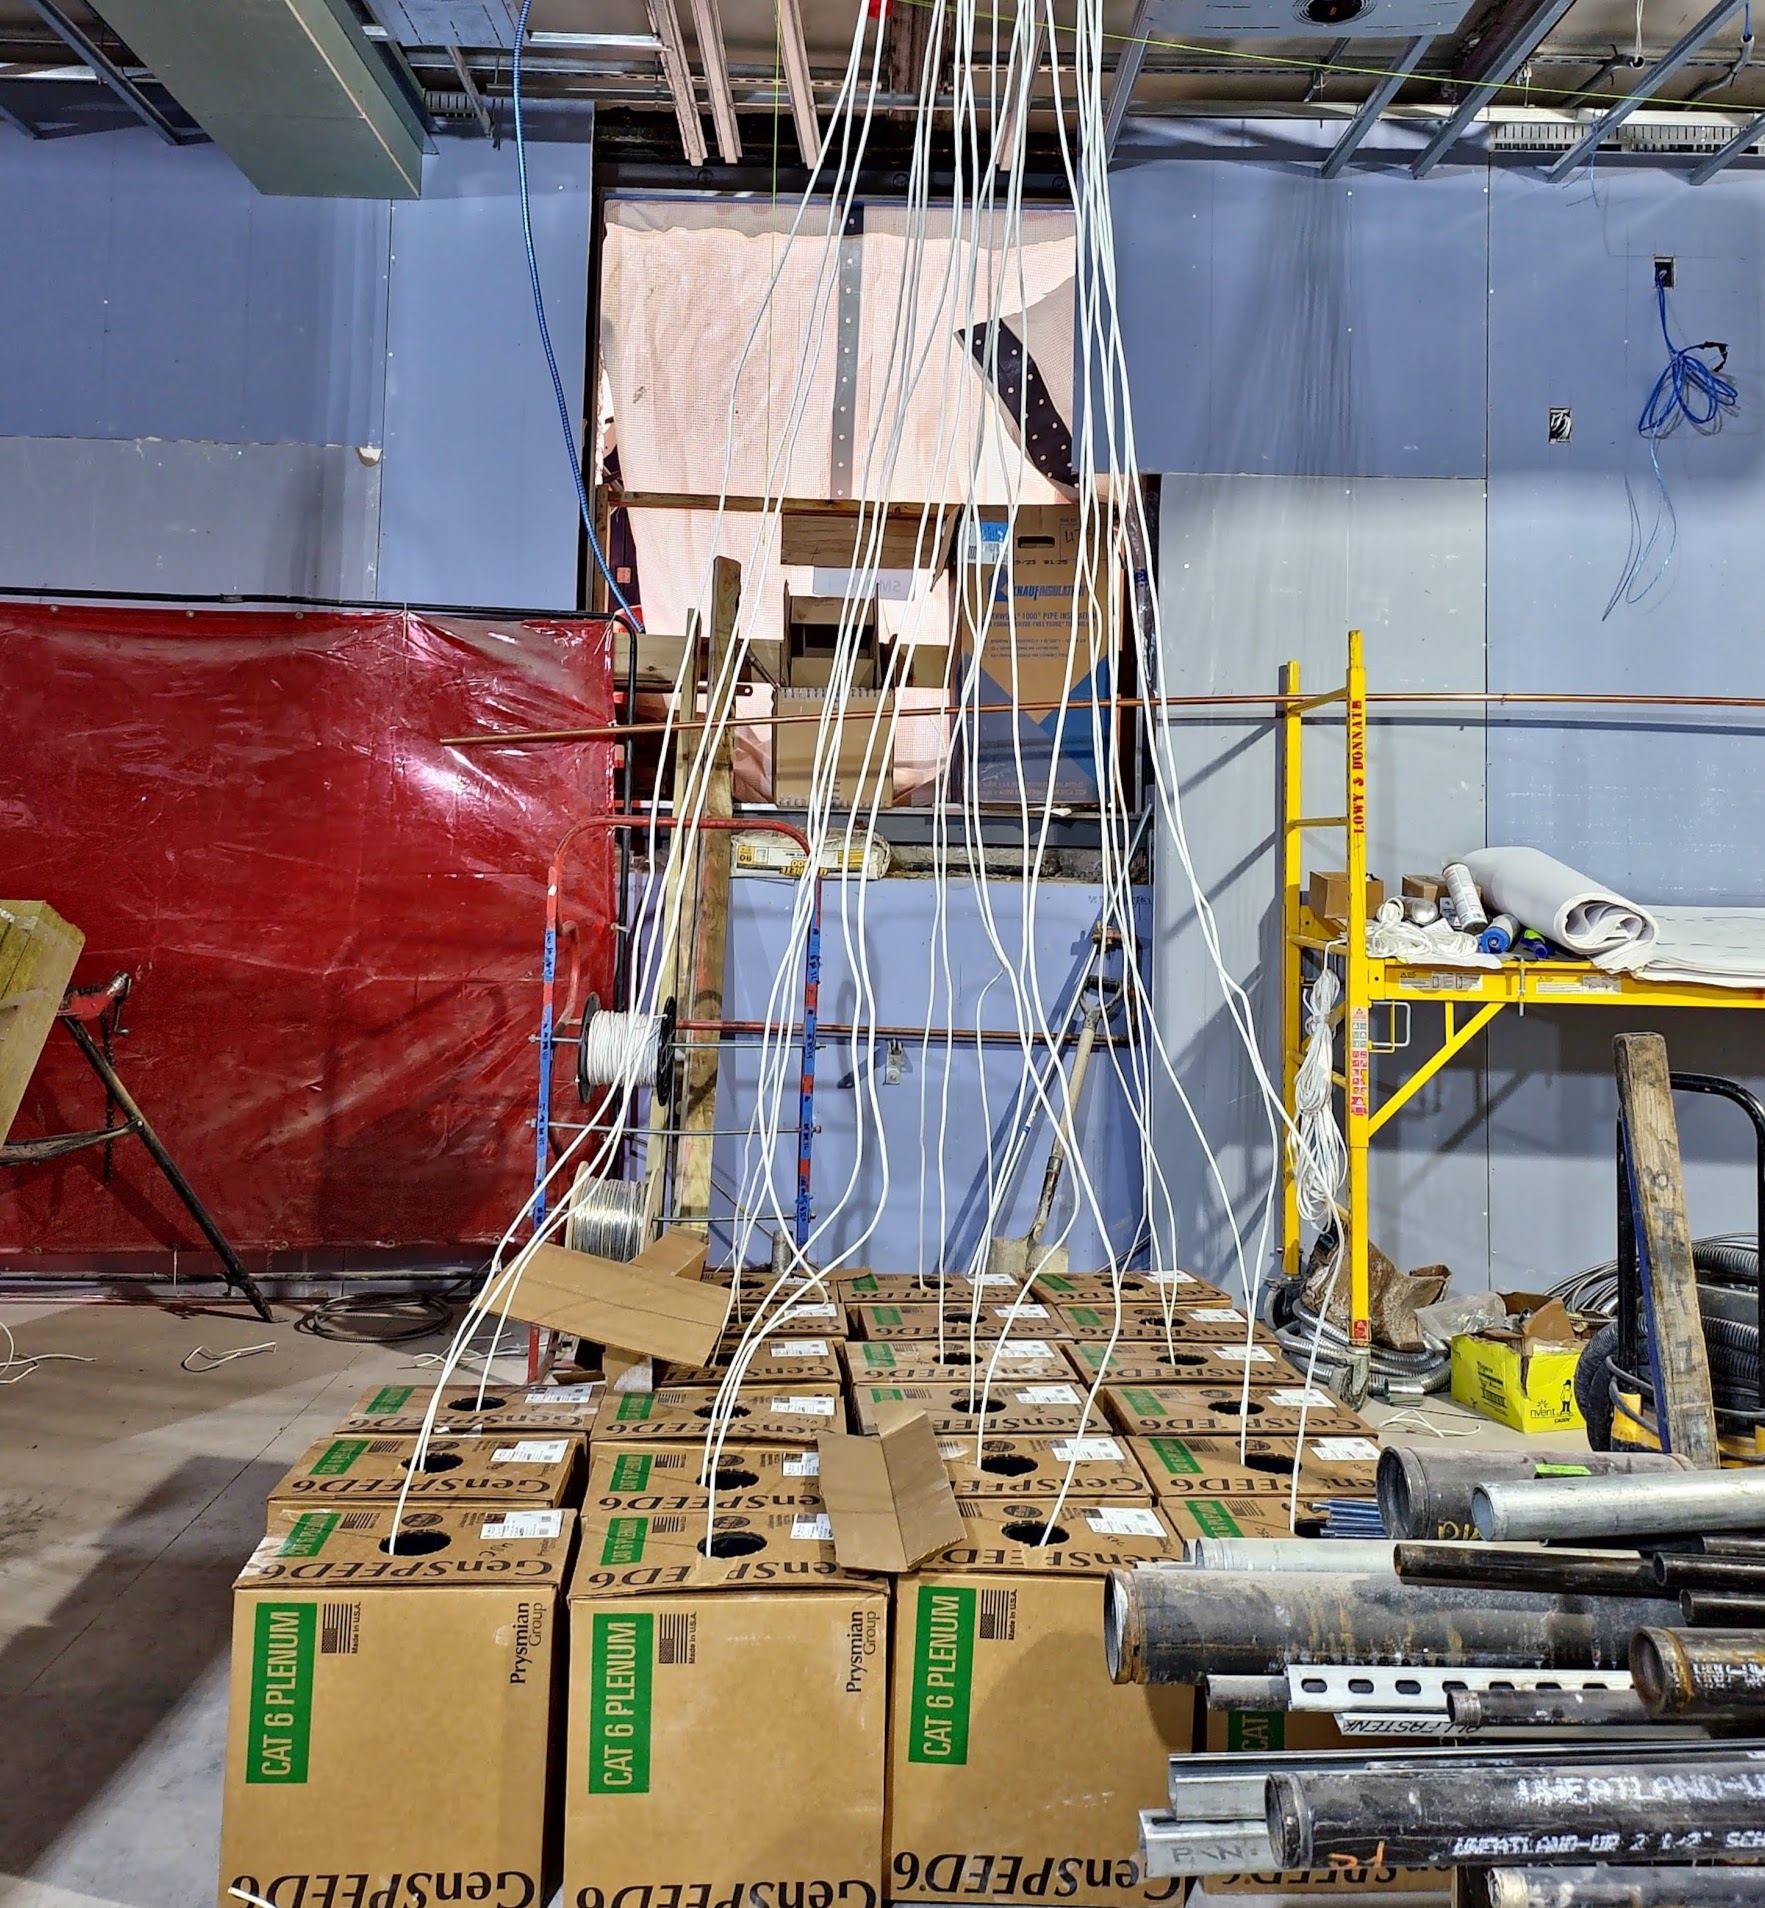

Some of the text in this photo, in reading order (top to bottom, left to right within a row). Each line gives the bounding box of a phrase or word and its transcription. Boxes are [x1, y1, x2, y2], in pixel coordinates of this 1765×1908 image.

[933, 1416, 1099, 1433] GenSPEE
[1139, 1416, 1362, 1432] GenSPED6
[949, 1477, 1144, 1498] GenSPEE
[598, 1494, 824, 1511] enSPEED6
[1009, 1589, 1018, 1610] U.S.A.
[352, 1601, 361, 1623] U.S.A.
[689, 1611, 697, 1633] U.S.A.
[528, 1602, 548, 1647] Group
[862, 1611, 881, 1656] Group
[1006, 1622, 1015, 1641] Made
[351, 1633, 359, 1654] Made
[509, 1602, 533, 1684] Prysmian
[688, 1643, 696, 1664] Made
[845, 1611, 868, 1693] Prysmian
[922, 1594, 960, 1757] CAT 6 PLENUM
[260, 1611, 300, 1776] CAT 6 PLENUM
[603, 1622, 637, 1786] CAT 6 PLENUM
[1241, 1714, 1269, 1751] CAT
